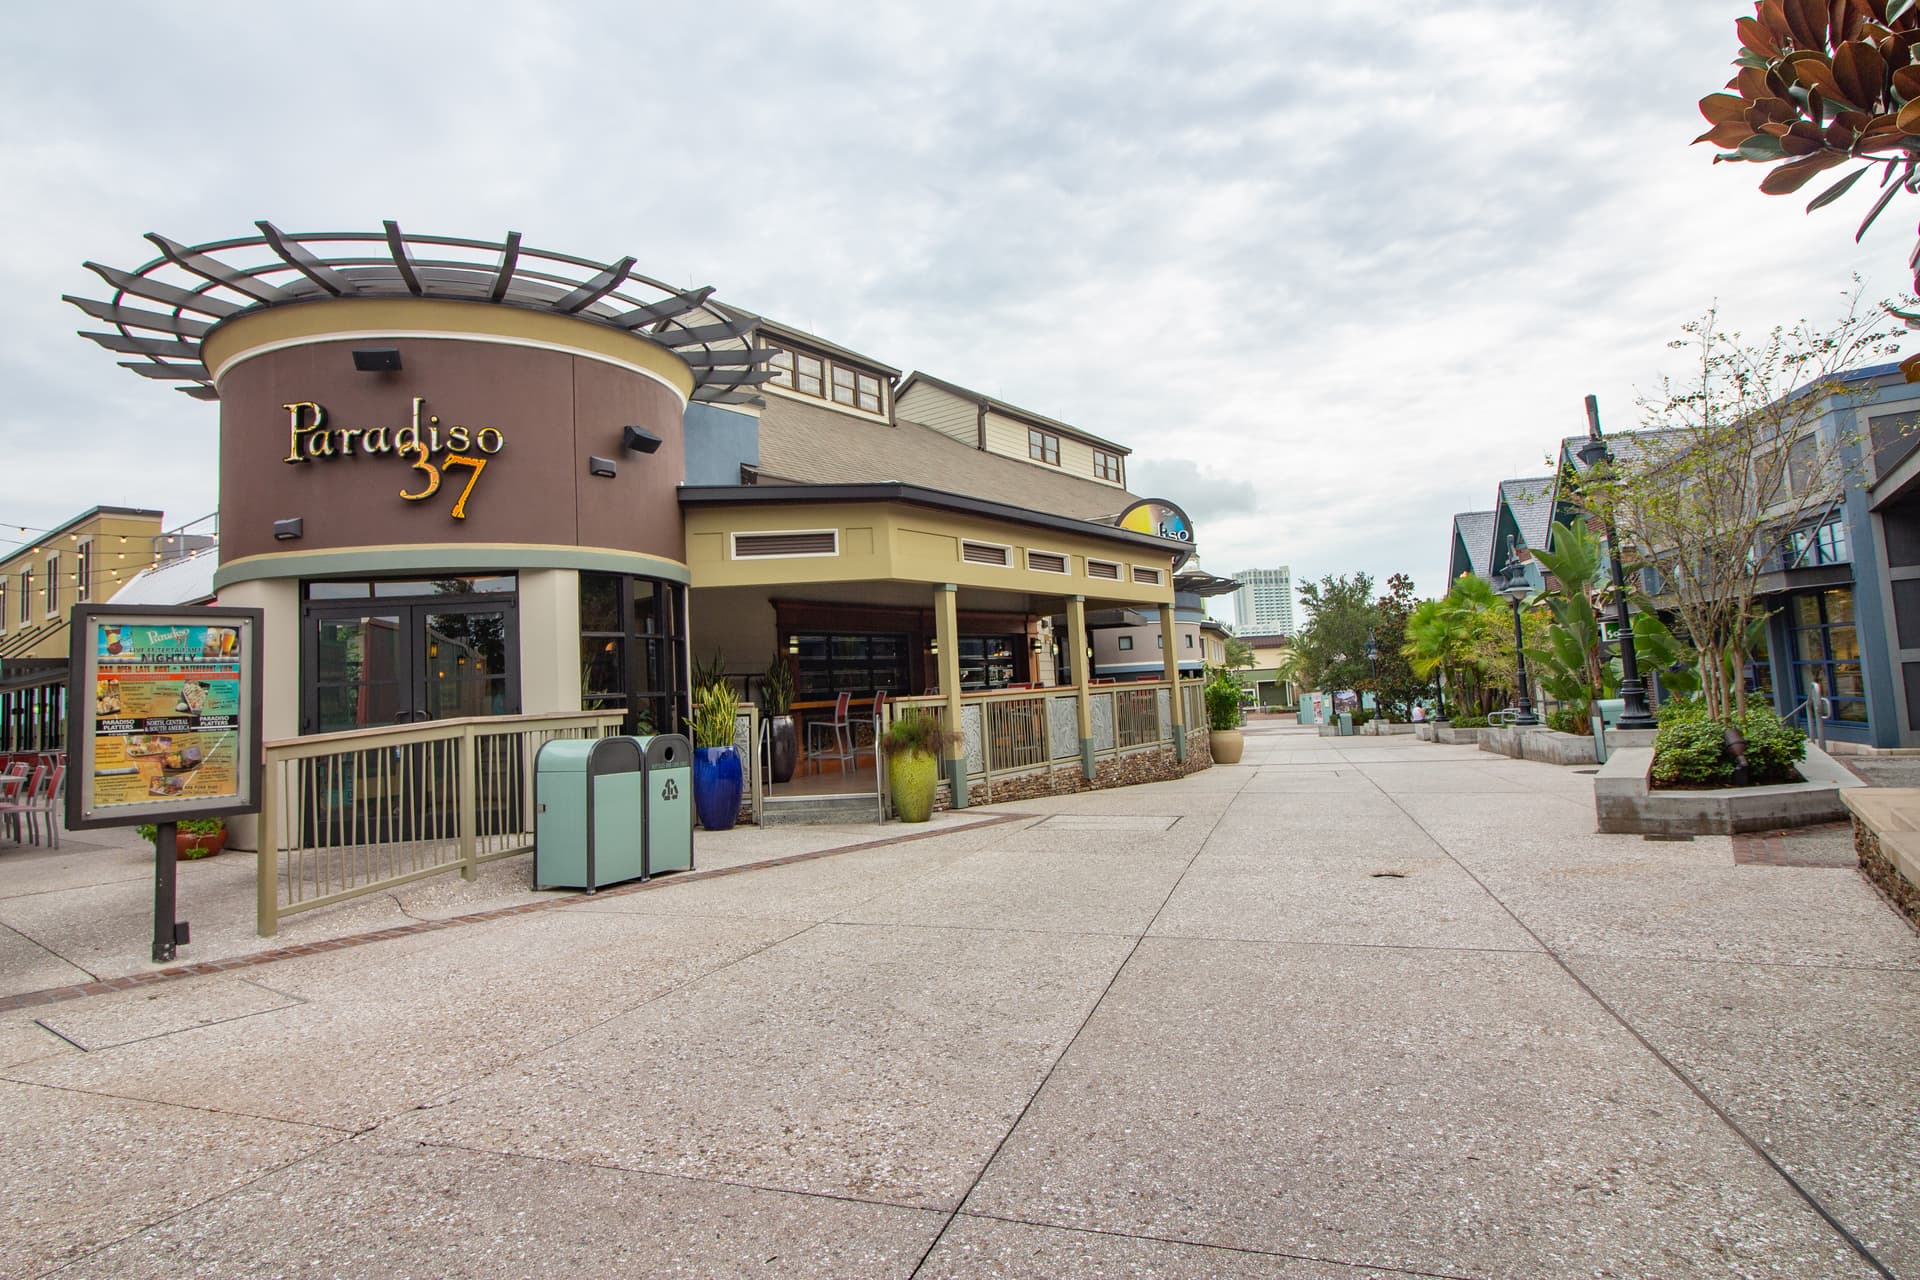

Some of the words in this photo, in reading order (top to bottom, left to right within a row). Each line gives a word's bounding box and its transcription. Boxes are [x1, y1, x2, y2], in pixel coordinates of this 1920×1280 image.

[283, 397, 505, 464] Paradiso
[400, 440, 487, 520] 37
[146, 626, 190, 645] Paradiso
[141, 654, 196, 663] NIGHTLY
[117, 665, 132, 673] OPEN
[136, 665, 150, 673] LATE
